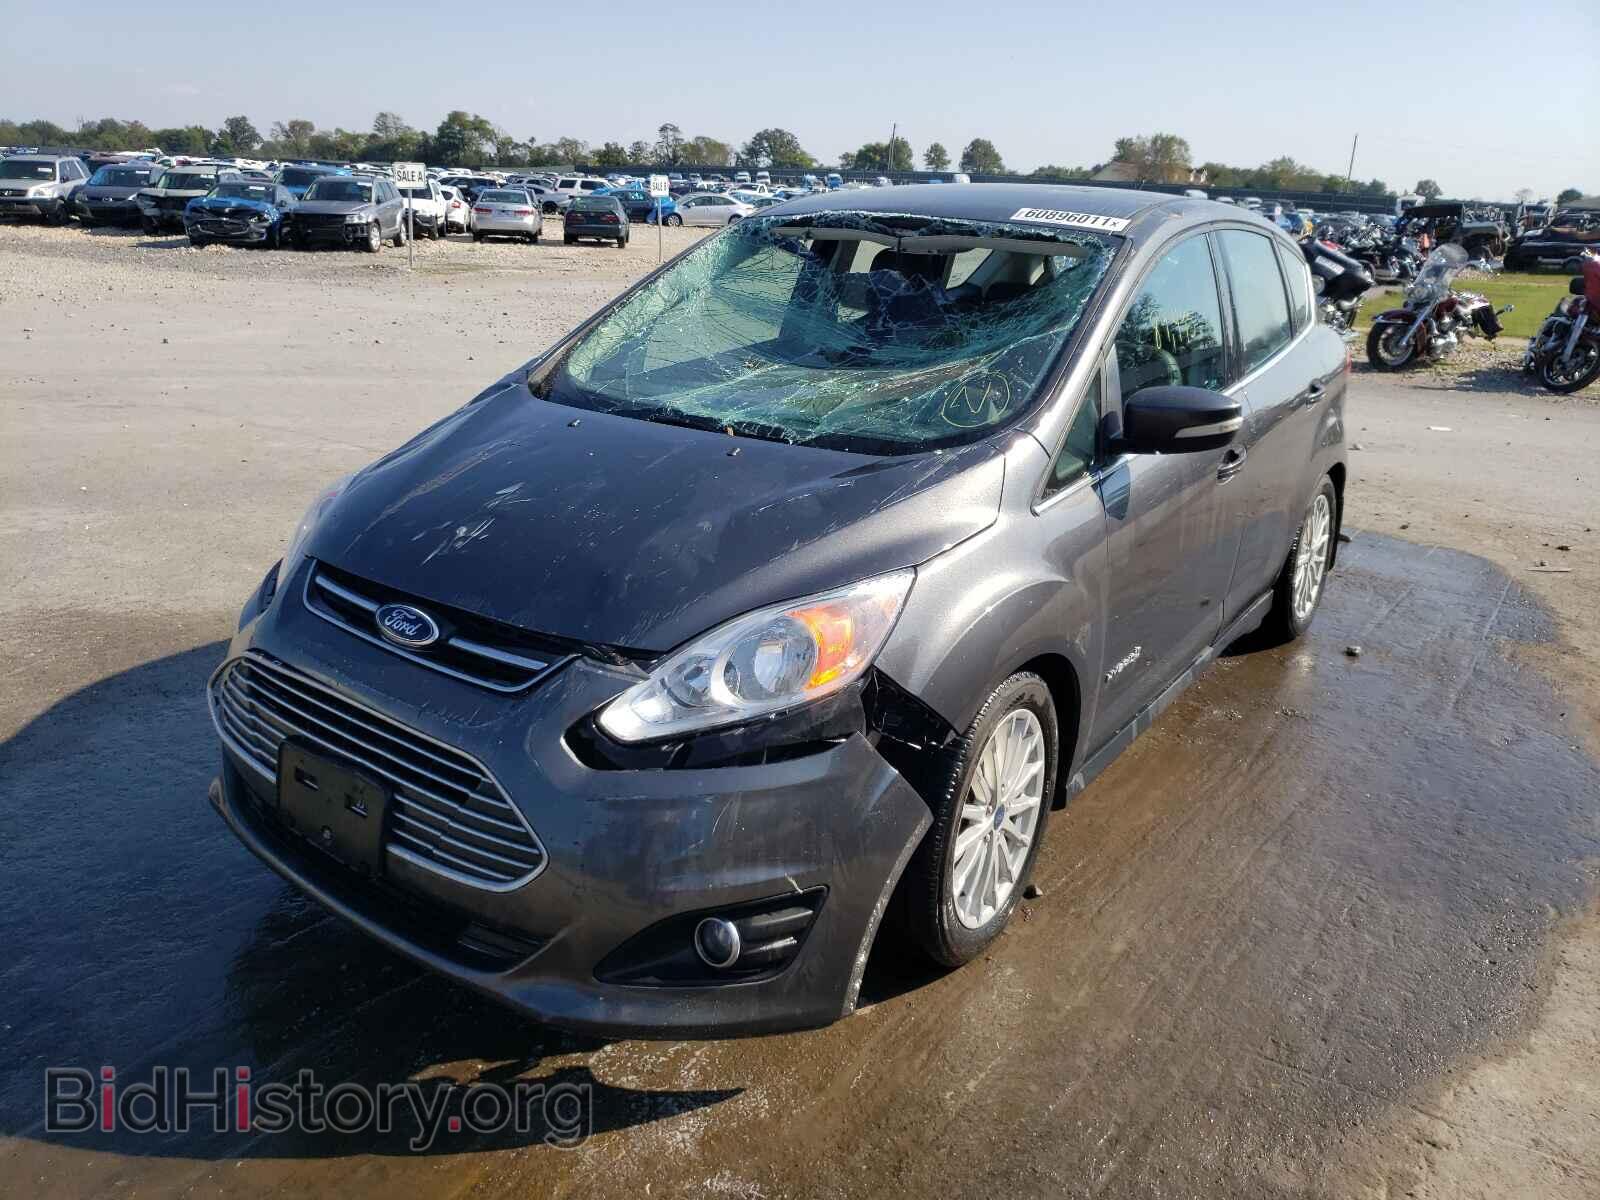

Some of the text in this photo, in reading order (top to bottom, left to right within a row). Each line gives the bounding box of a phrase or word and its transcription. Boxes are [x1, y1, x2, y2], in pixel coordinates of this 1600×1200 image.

[397, 171, 424, 182] SALE A
[652, 181, 663, 191] SALE
[384, 609, 423, 636] Ford
